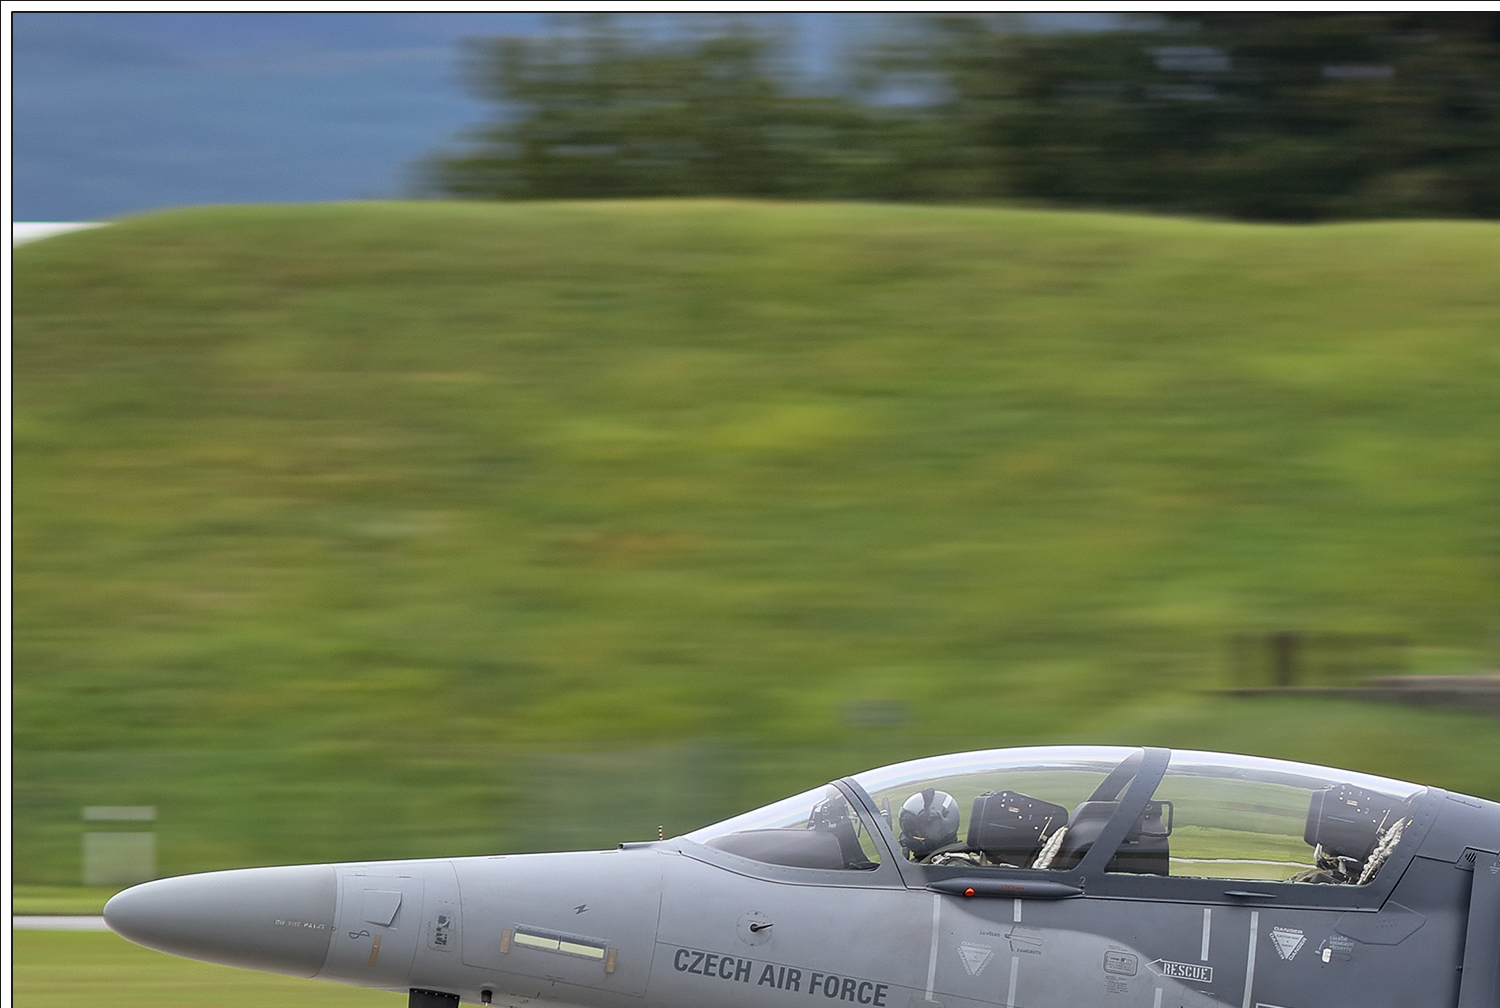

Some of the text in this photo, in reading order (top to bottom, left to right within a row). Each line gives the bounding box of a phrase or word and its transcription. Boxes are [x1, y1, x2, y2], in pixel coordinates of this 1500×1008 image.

[1273, 926, 1303, 935] DANGER
[1288, 937, 1308, 962] DANGER
[673, 948, 889, 1008] CZECH AIR FORCE
[1163, 962, 1208, 980] RESCUE
